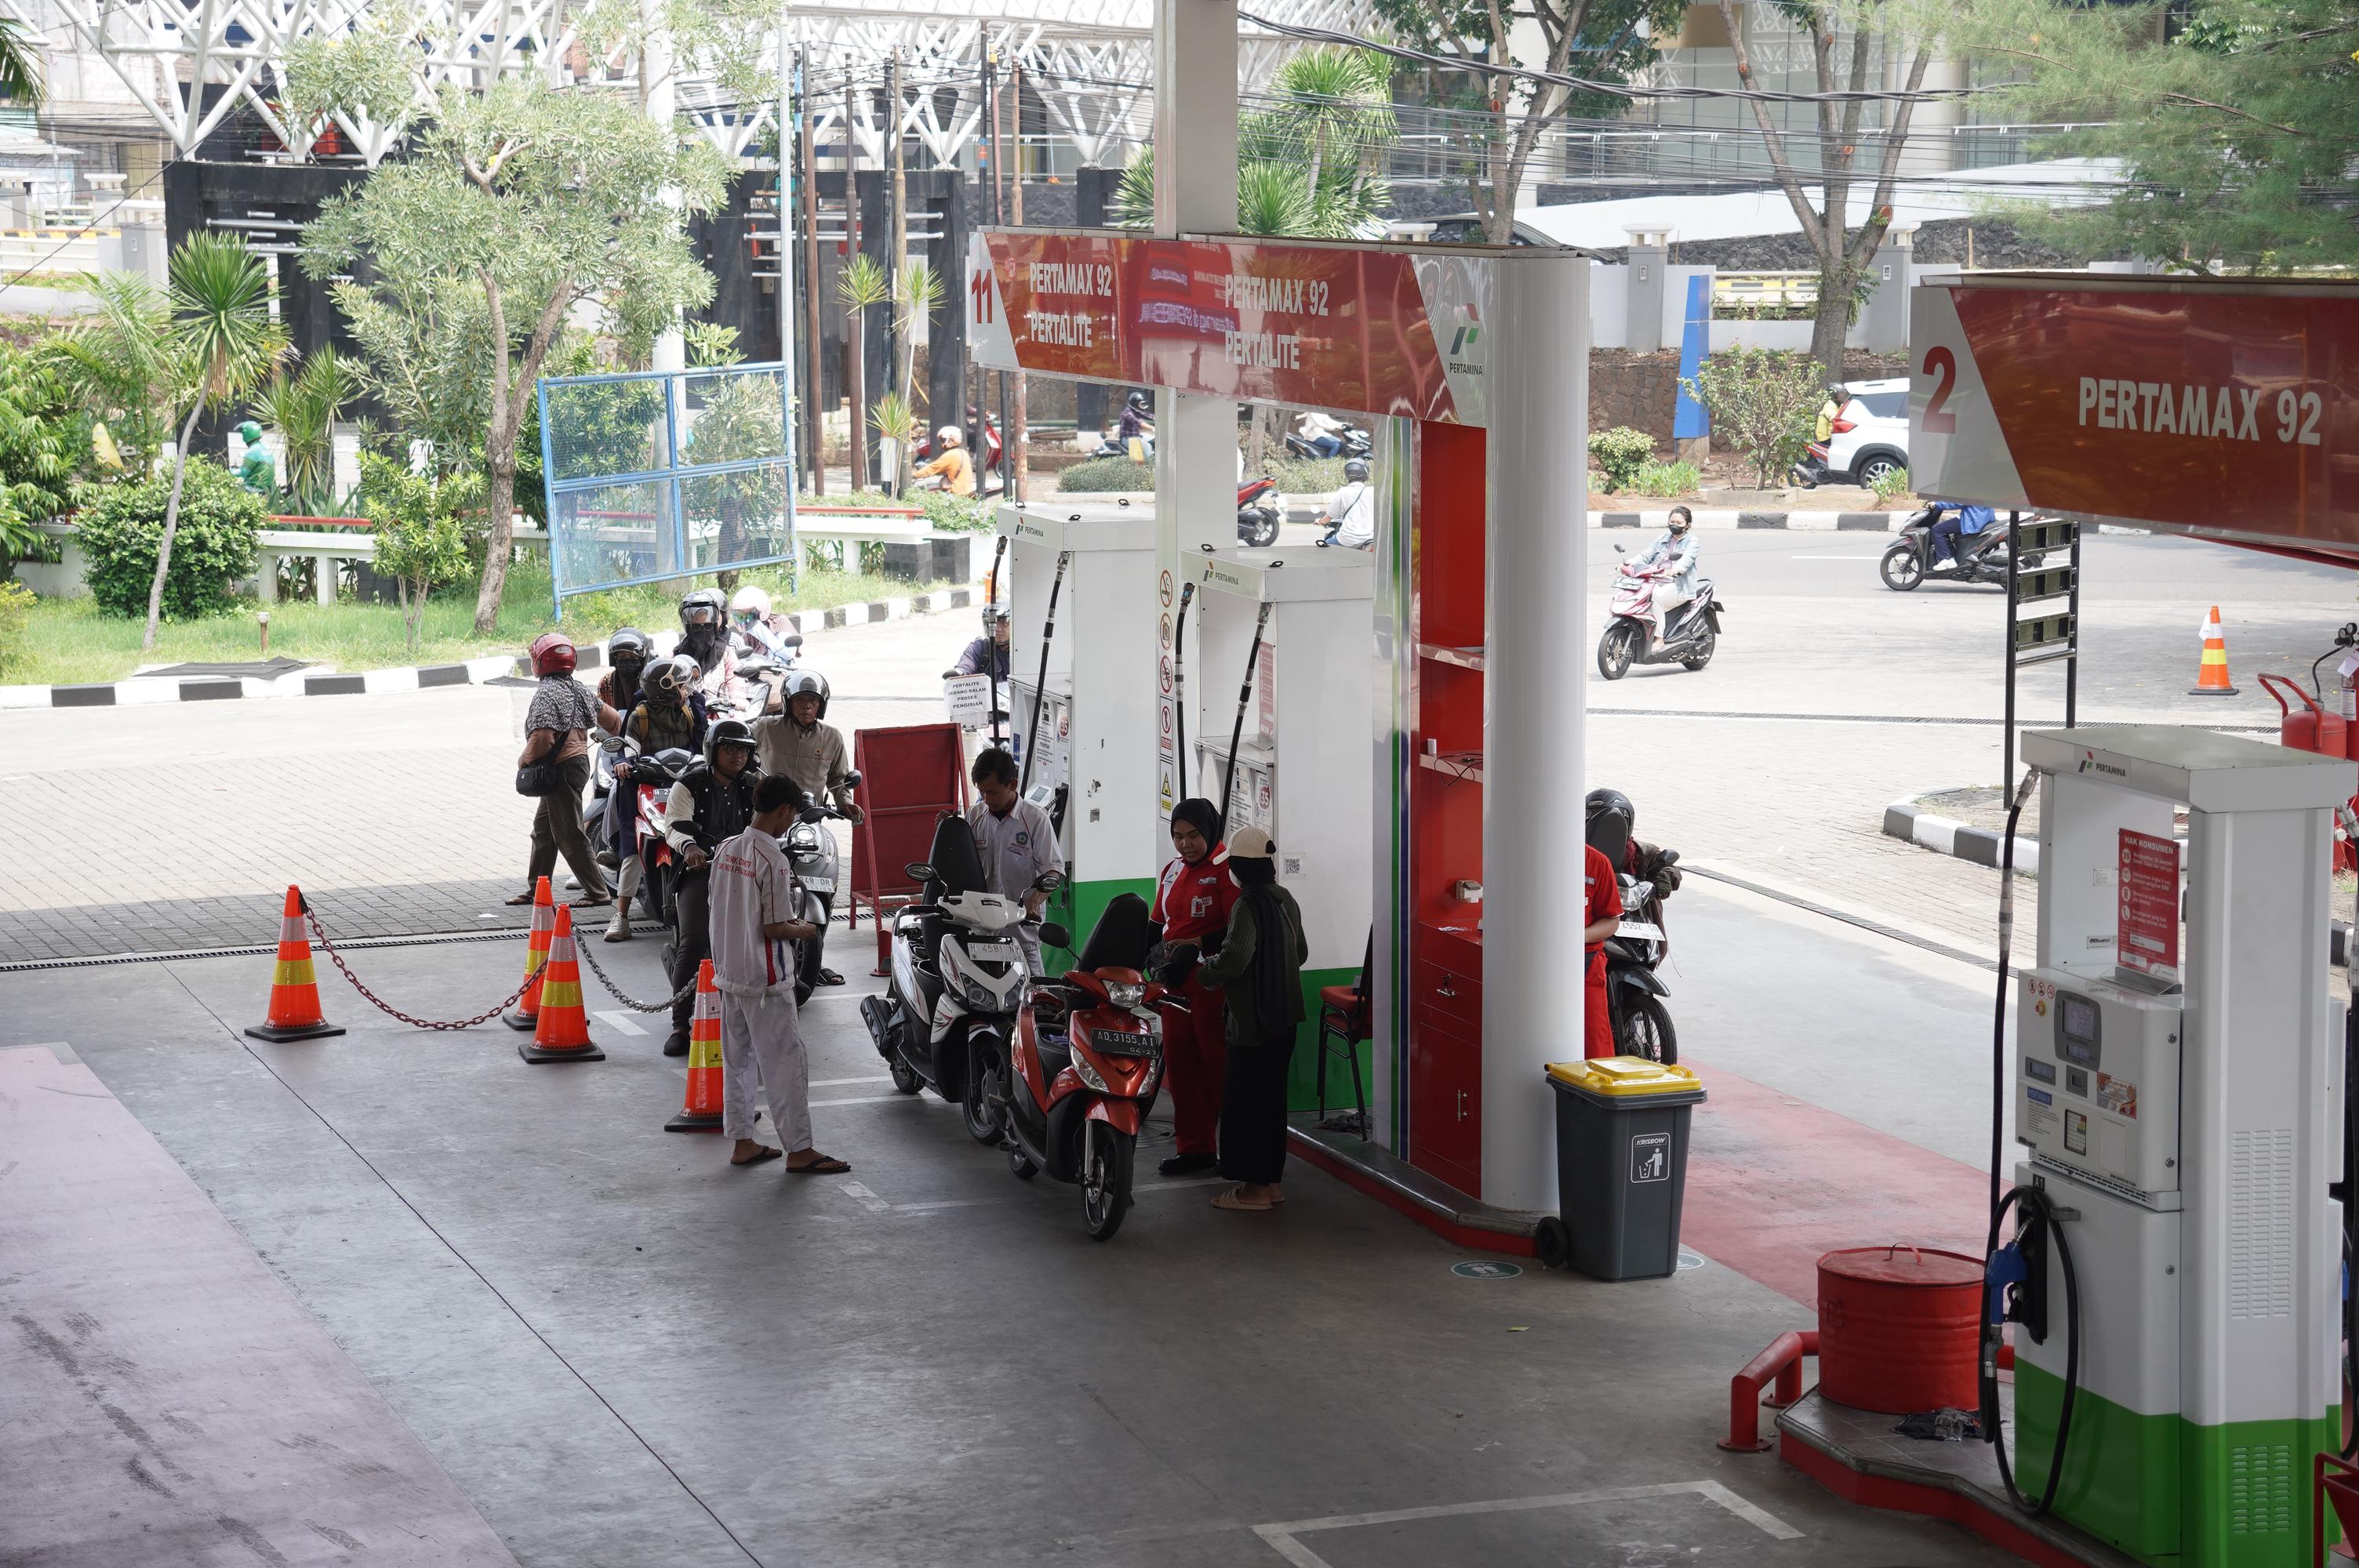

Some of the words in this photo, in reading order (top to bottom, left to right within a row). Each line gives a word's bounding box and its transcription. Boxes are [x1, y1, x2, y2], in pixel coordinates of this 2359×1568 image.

[1030, 263, 1093, 296] PERTAMAX
[1098, 264, 1112, 297] 92
[972, 270, 992, 324] 11
[1225, 274, 1303, 314] PERTAMAX
[1310, 280, 1329, 317] 92
[1031, 312, 1092, 348] PERTALITE
[1225, 331, 1300, 370] PERTALITE
[1449, 362, 1483, 376] PERTAMINA
[1922, 347, 1957, 434] 2
[2079, 377, 2261, 442] PERTAMAX
[2277, 389, 2321, 446] 92
[1024, 525, 1044, 537] PERTAMINA
[1215, 572, 1239, 586] PERTAMINA
[2095, 762, 2127, 778] PERTAMINA
[2124, 836, 2138, 846] HAK
[2139, 839, 2174, 855] KONSUMEN
[983, 944, 1004, 953] 4581
[1636, 1137, 1666, 1145] KRISBOW
